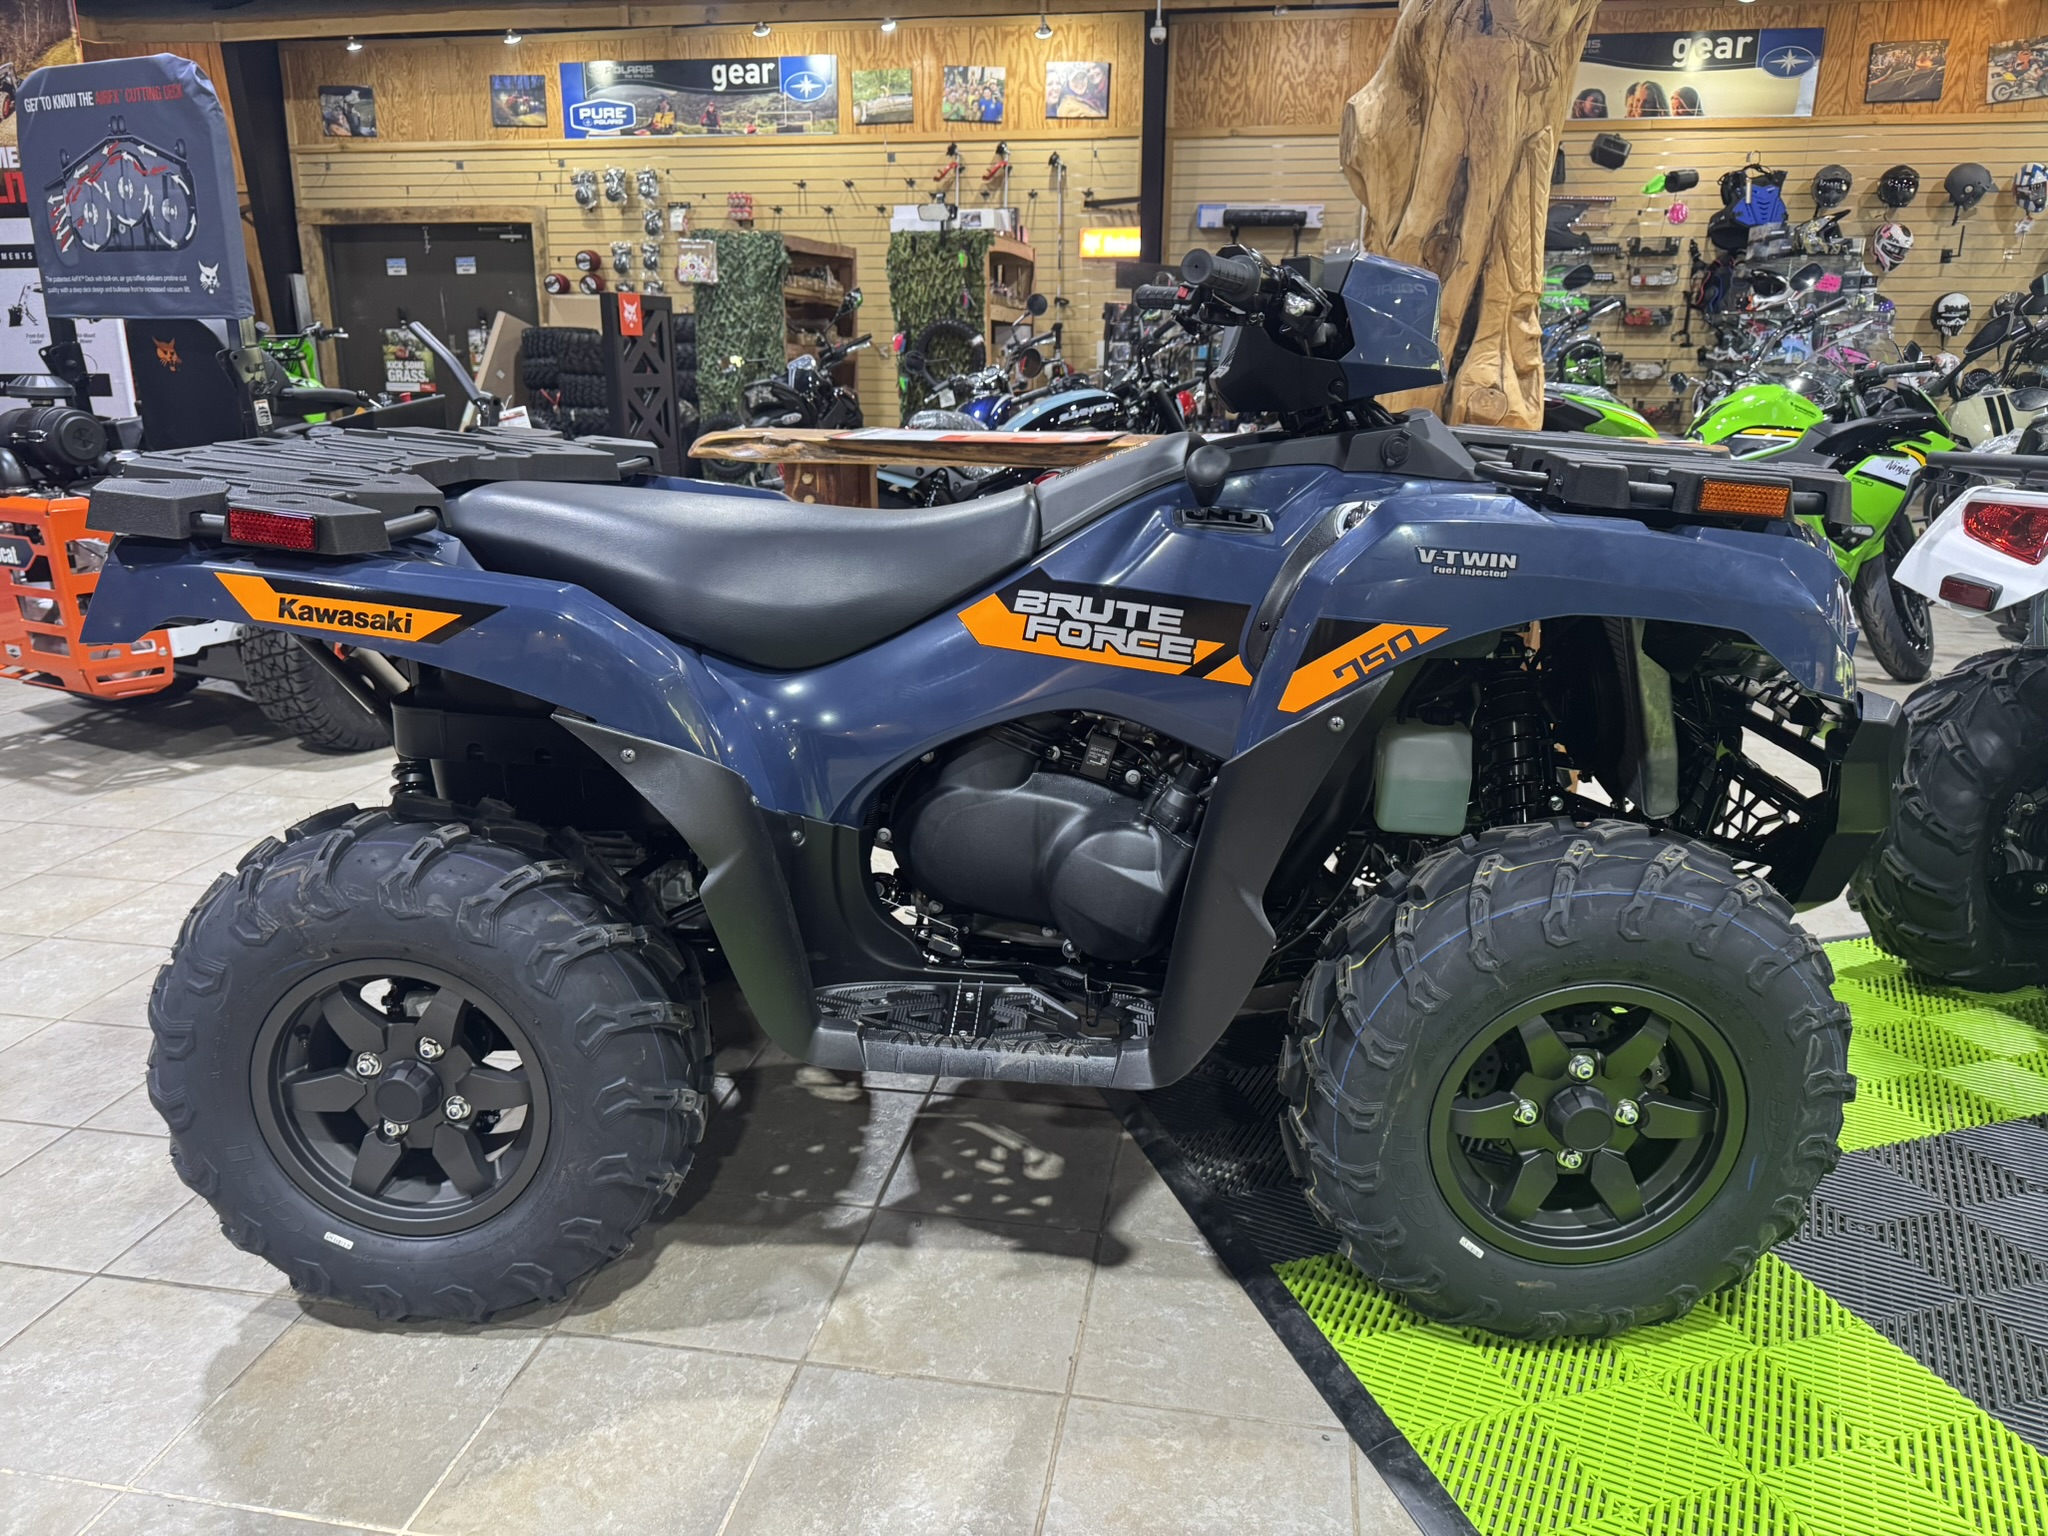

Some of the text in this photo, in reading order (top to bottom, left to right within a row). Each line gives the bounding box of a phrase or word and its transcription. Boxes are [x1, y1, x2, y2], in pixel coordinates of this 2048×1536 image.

[1672, 35, 1754, 67] gear
[711, 61, 776, 92] gear
[24, 97, 38, 113] GET
[39, 96, 52, 111] TO
[52, 93, 77, 110] KNOW
[77, 91, 94, 107] THE
[125, 85, 162, 103] CUTTING
[162, 83, 183, 100] DECK
[579, 107, 627, 120] PURE
[385, 360, 426, 369] KICK SOME
[387, 369, 430, 383] GRASS.
[1885, 460, 1911, 476] Ninja
[1416, 545, 1517, 569] V-TWIN
[1433, 565, 1508, 578] Fuel Injected
[278, 597, 413, 634] Kawasaki
[1013, 589, 1184, 635] BRUTE
[1025, 615, 1195, 663] FORCE
[1332, 628, 1420, 681] 750
